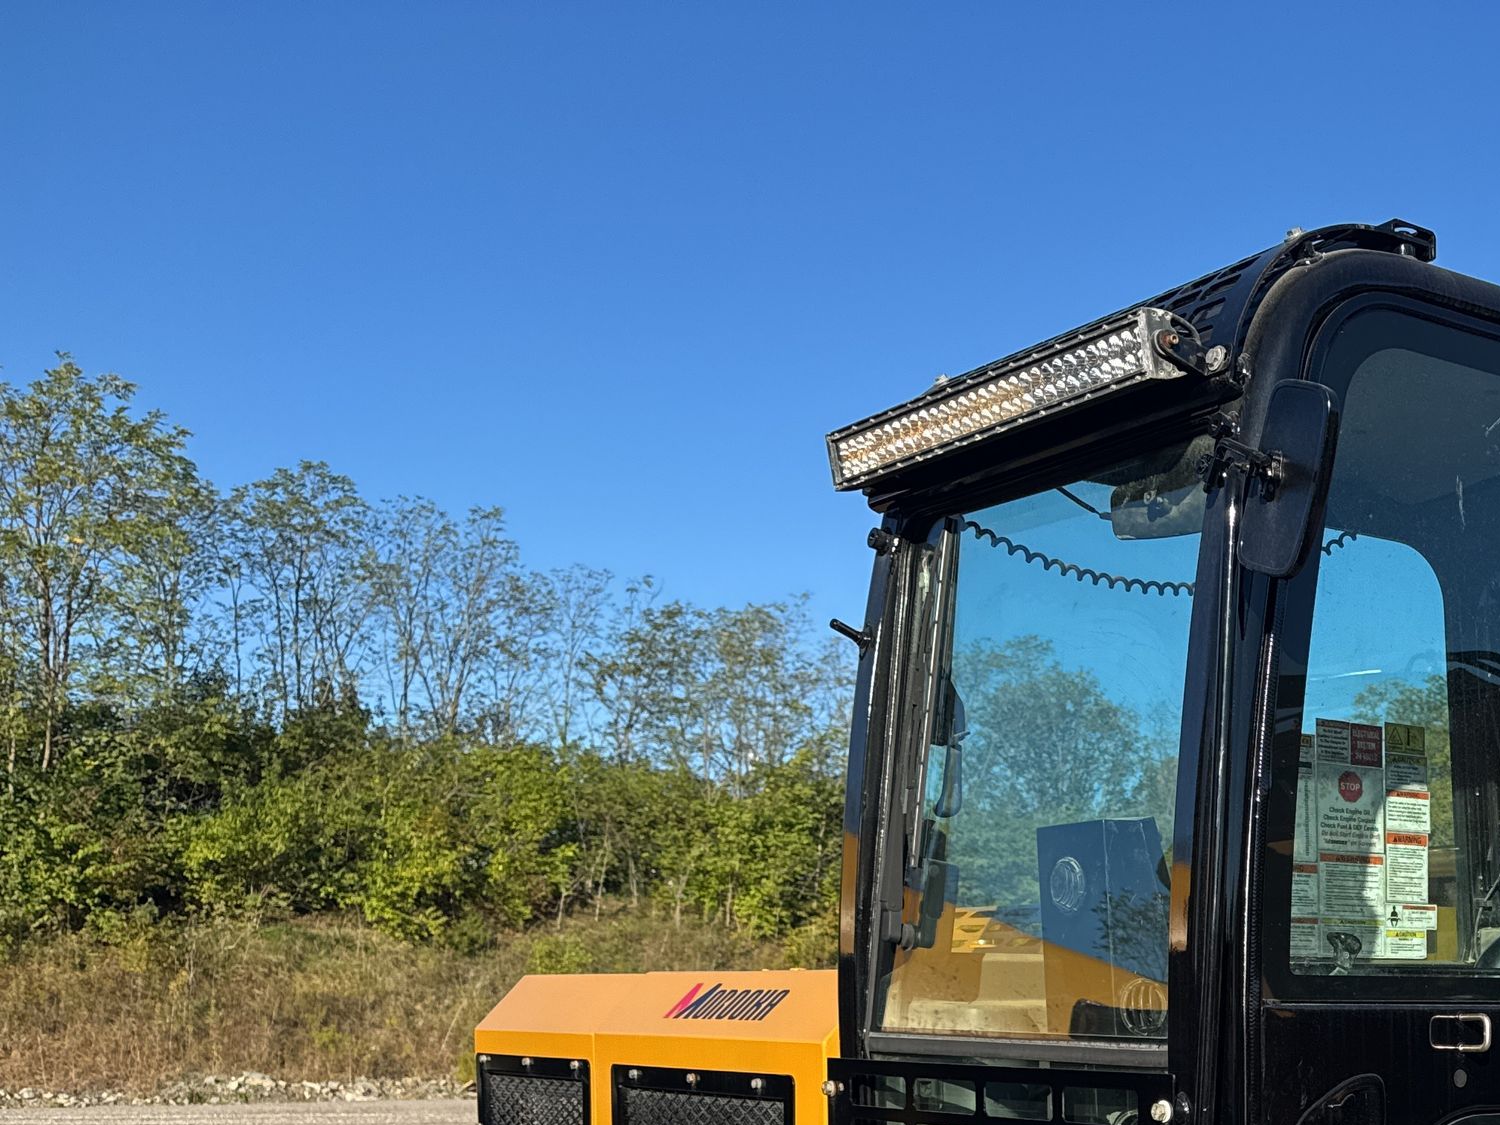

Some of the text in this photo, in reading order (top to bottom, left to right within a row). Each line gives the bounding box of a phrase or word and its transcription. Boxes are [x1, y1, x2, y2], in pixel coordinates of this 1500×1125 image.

[1340, 783, 1361, 791] STOP
[1340, 815, 1356, 823] Engine
[663, 983, 790, 1020] MOROOKA
